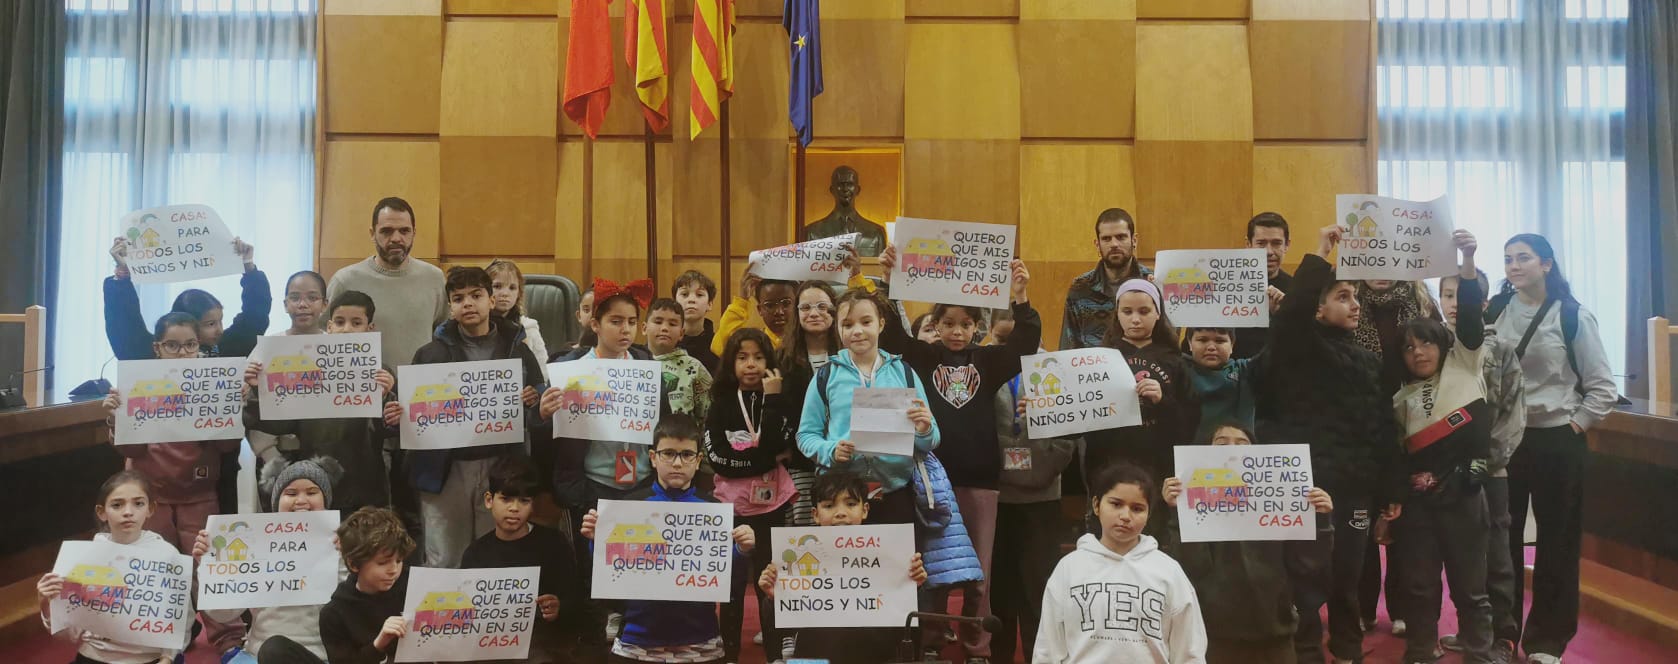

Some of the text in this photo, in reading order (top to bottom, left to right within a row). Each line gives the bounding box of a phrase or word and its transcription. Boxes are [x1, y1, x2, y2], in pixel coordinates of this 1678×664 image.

[178, 226, 210, 237] PARA
[1396, 225, 1431, 236] PARA
[954, 232, 1005, 244] QUIERO
[128, 243, 203, 259] TODOS LOS
[951, 244, 1009, 257] QUE MIS
[1343, 239, 1421, 252] TODOS LOS
[815, 251, 831, 261] EN
[1341, 253, 1386, 266] NIÑOS
[1392, 257, 1400, 266] Y
[132, 262, 175, 274] NIÑOS
[180, 261, 187, 270] Y
[810, 262, 843, 273] CASA
[934, 256, 1008, 271] AMIGOS SE
[1210, 259, 1258, 269] QUIERO
[908, 267, 1007, 283] QUEDEN EN SU
[1208, 271, 1264, 281] QUE MIS
[961, 283, 999, 296] CASA
[1193, 283, 1264, 292] AMIGOS SE
[1170, 295, 1264, 305] QUEDEN EN SU
[1222, 306, 1258, 316] CASA
[316, 343, 370, 356] QUIERO
[316, 357, 376, 369] QUE MIS
[182, 368, 236, 380] QUIERO
[301, 369, 376, 380] AMIGOS SE
[461, 370, 512, 383] QUIERO
[608, 368, 653, 379] QUIERO
[1078, 371, 1110, 384] PARA
[181, 380, 242, 393] QUE MIS
[275, 383, 377, 396] QUEDEN EN SU
[459, 383, 519, 396] QUE MIS
[608, 380, 657, 393] QUE MIS
[163, 392, 241, 404] AMIGOS SE
[333, 395, 372, 406] CASA
[443, 395, 519, 409] AMIGOS SE
[594, 392, 640, 404] AMIGOS
[644, 396, 656, 406] SE
[1027, 391, 1104, 408] TODOS LOS
[135, 405, 240, 421] QUEDEN EN SU
[417, 409, 519, 426] QUEDEN EN SU
[569, 403, 655, 419] QUEDEN EN SU
[194, 418, 234, 428] CASA
[620, 419, 650, 431] CASA
[1030, 411, 1075, 427] NIÑOS
[1080, 410, 1087, 420] Y
[475, 421, 512, 433] CASA
[1243, 456, 1301, 469] QUIERO
[1242, 471, 1308, 484] QUE MIS
[1224, 486, 1309, 497] AMIGOS SE
[1196, 501, 1310, 515] QUEDEN EN SU
[665, 514, 723, 527] QUIERO
[1259, 515, 1303, 526] CASA
[662, 529, 728, 542] QUE MIS
[270, 541, 307, 552] PARA
[643, 544, 728, 557] AMIGOS SE
[129, 558, 183, 575] QUIERO
[207, 561, 296, 575] TODOS LOS
[613, 558, 727, 572] QUEDEN EN SU
[842, 557, 881, 568] PARA
[124, 573, 187, 590] QUE MIS
[205, 579, 258, 594] NIÑOS
[265, 581, 274, 591] Y
[476, 579, 529, 593] QUIERO
[676, 574, 719, 587] CASA
[779, 577, 871, 590] TODOS LOS
[101, 587, 186, 605] AMIGOS SE
[472, 594, 534, 606] QUE MIS
[69, 594, 183, 619] QUEDEN EN SU
[780, 595, 833, 612] NIÑOS
[840, 599, 849, 610] Y
[451, 607, 532, 620] AMIGOS SE
[1070, 583, 1166, 640] YES
[129, 618, 174, 634] CASA
[421, 622, 528, 637] QUEDEN EN SU
[478, 635, 519, 647] CASA
